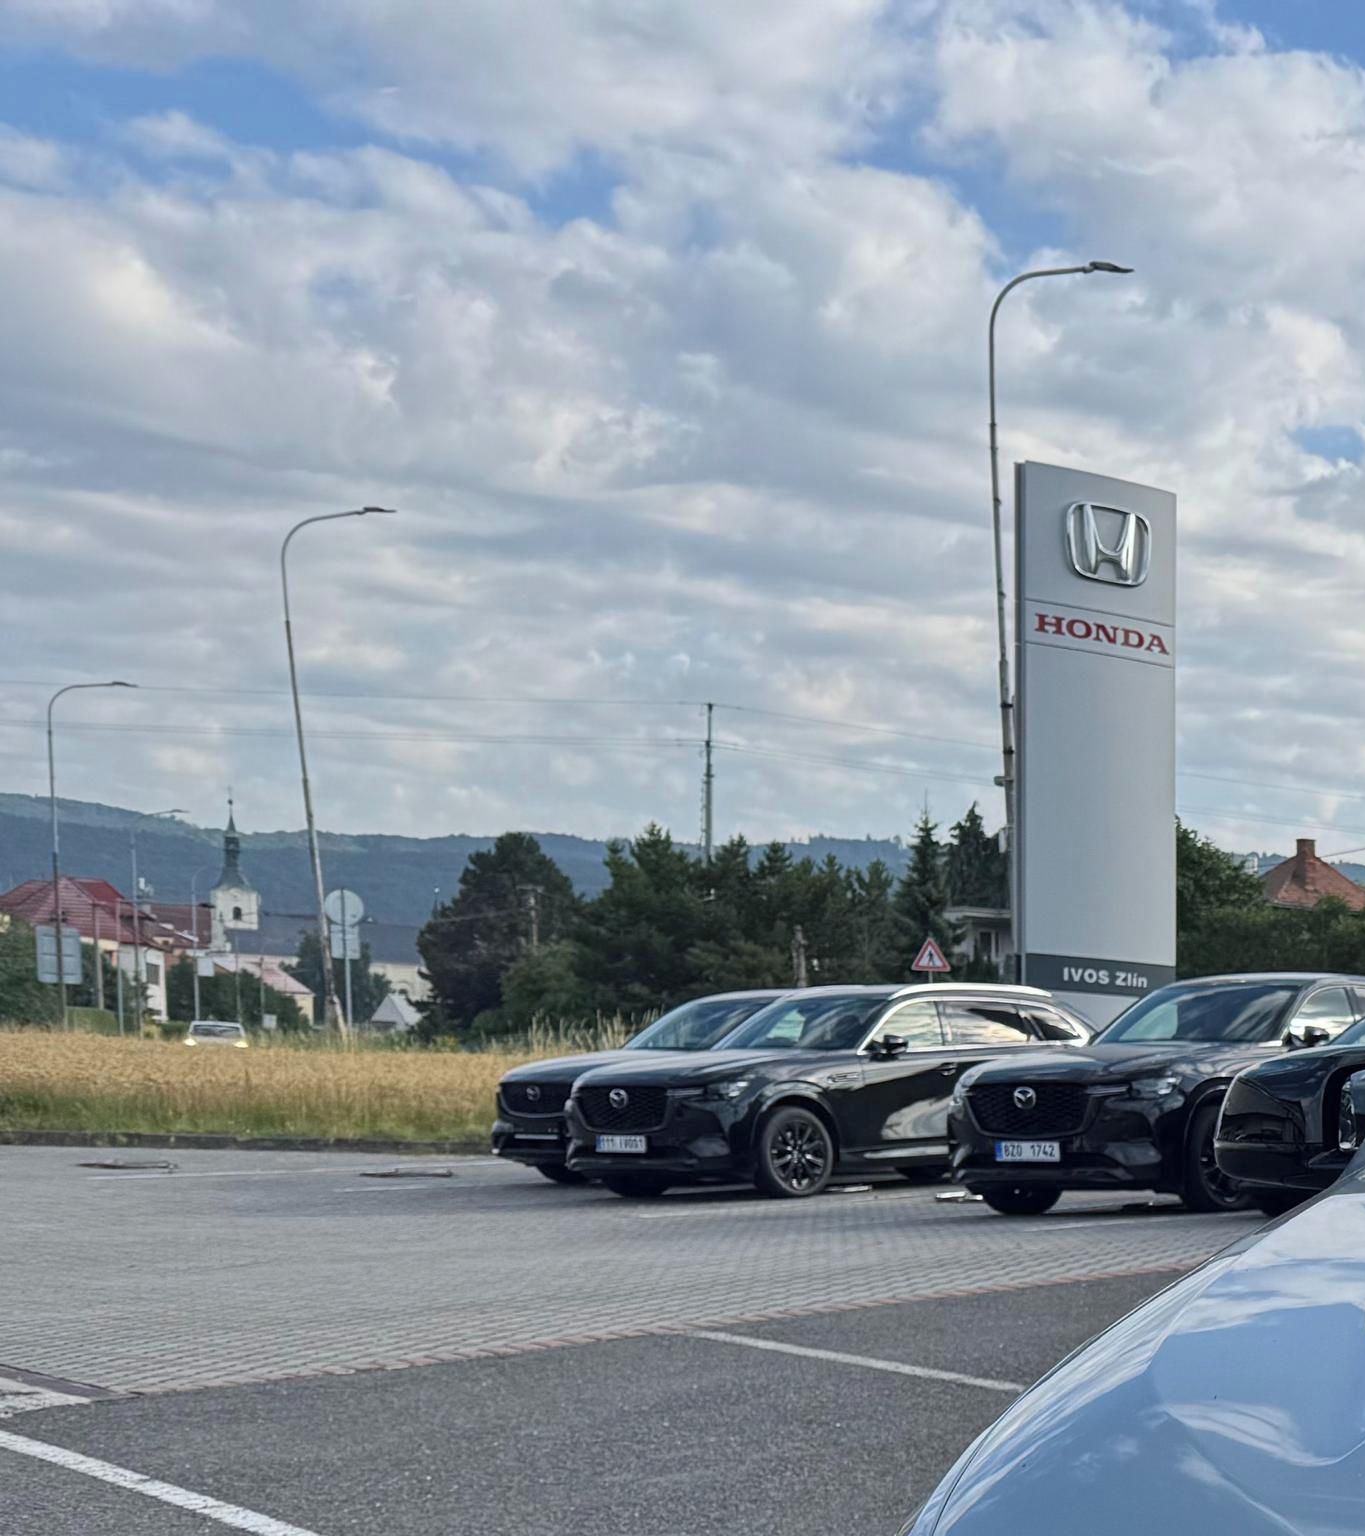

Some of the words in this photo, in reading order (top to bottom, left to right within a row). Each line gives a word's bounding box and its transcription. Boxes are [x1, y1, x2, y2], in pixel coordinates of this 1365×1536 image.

[1034, 612, 1170, 656] HONDA
[1063, 967, 1110, 985] IVOS
[1115, 971, 1148, 988] Zlín
[1031, 1144, 1055, 1157] 1742
